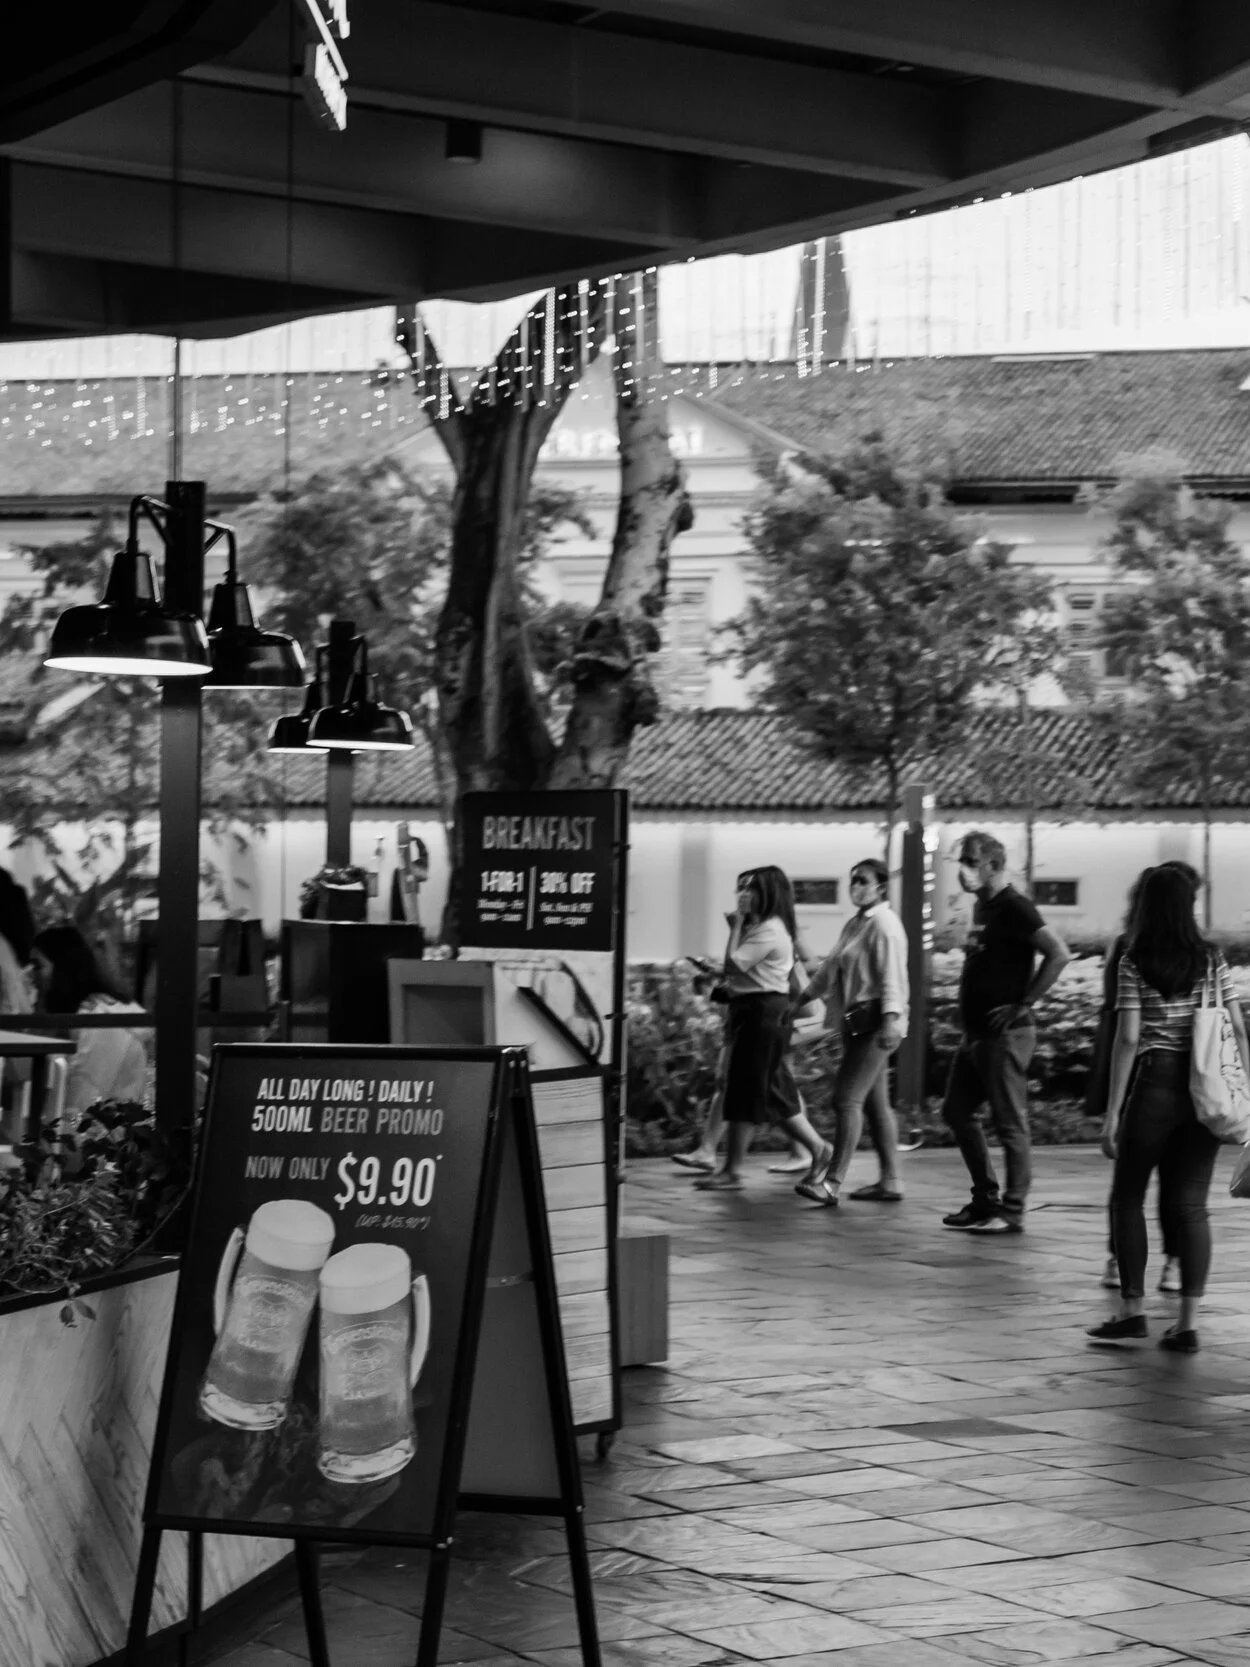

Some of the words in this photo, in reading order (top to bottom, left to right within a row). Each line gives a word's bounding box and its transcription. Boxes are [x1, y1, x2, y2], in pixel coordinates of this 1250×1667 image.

[482, 816, 596, 850] BREAKFAST
[539, 872, 568, 894] 30%
[570, 872, 596, 894] OFF
[256, 1078, 285, 1100] ALL
[287, 1078, 321, 1101] DAY
[322, 1079, 365, 1102] LONG
[376, 1080, 424, 1103] DAILY
[251, 1105, 313, 1132] 500ML
[320, 1106, 369, 1134] BEER
[374, 1108, 443, 1136] PROMO
[244, 1155, 285, 1179] NOW
[288, 1157, 331, 1181] ONLY
